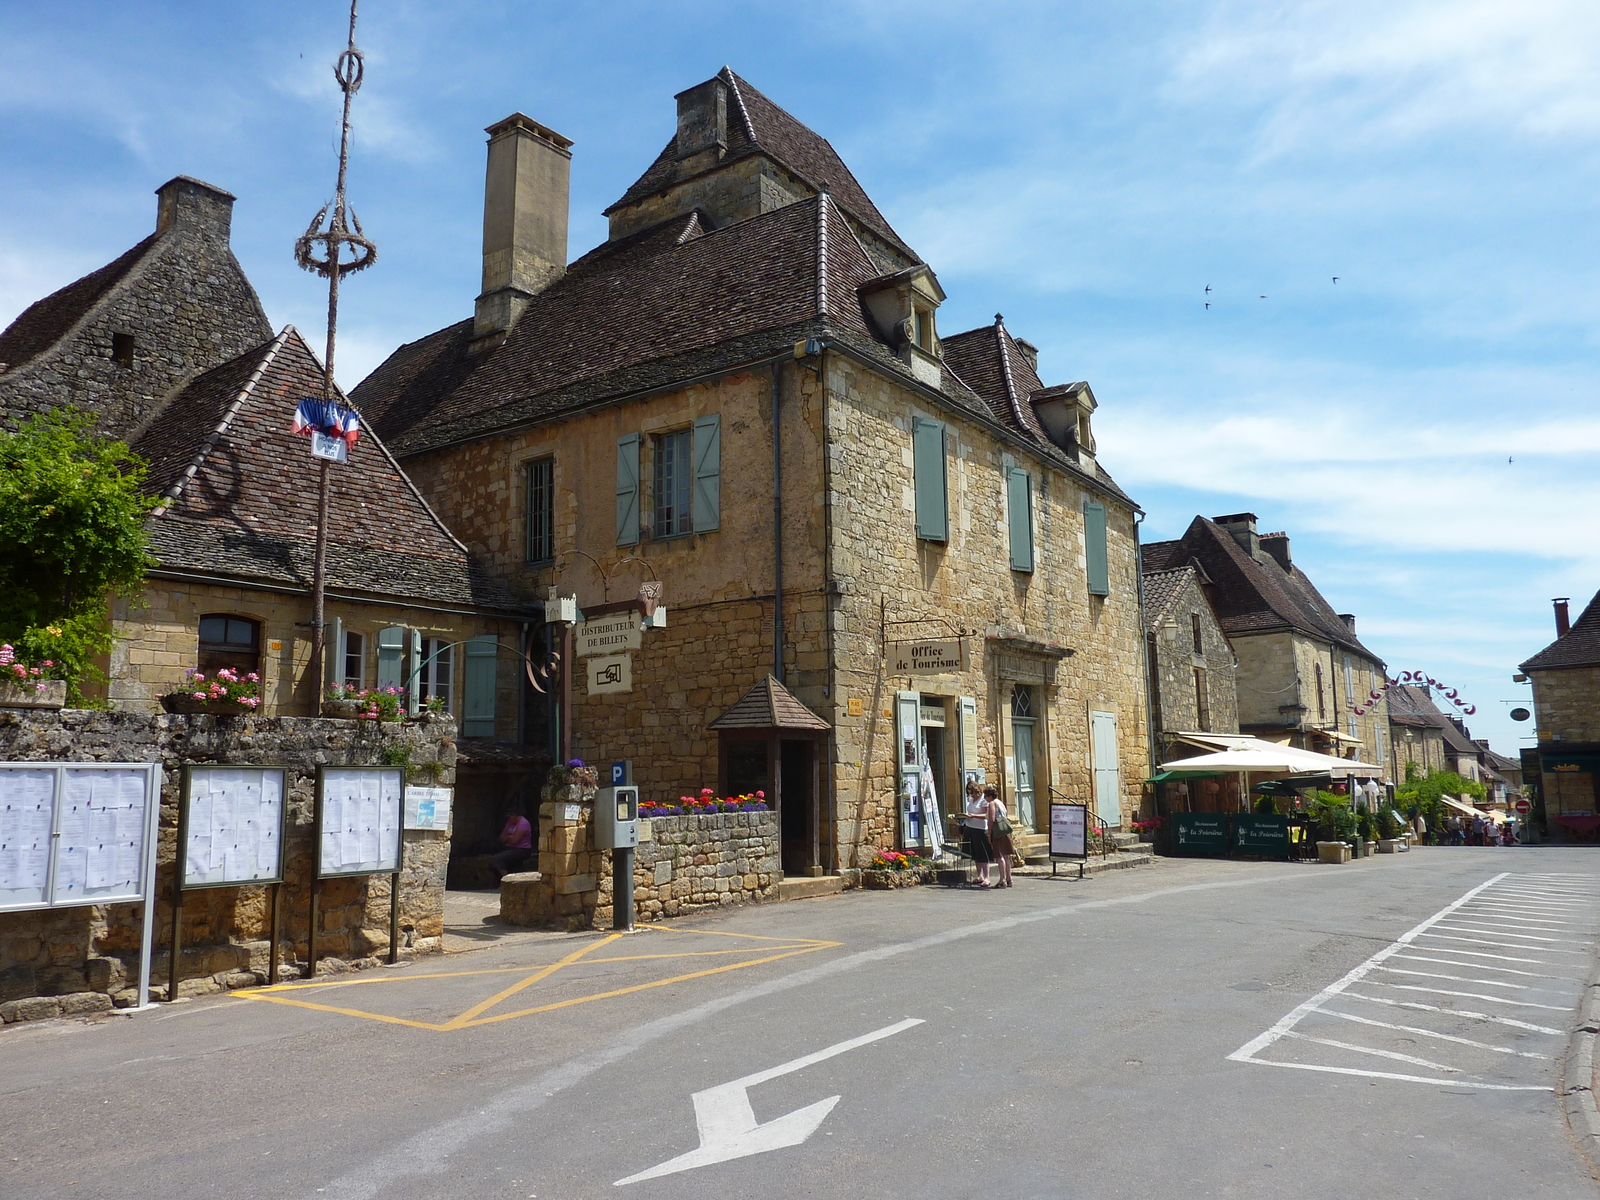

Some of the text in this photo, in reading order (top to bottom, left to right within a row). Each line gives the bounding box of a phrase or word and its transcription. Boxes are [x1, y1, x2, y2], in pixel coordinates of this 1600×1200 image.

[581, 620, 635, 636] DISTRIBUTEUR
[587, 634, 628, 648] DE BILLETS
[911, 645, 943, 658] Office
[896, 657, 959, 670] de Tourisme
[612, 766, 623, 782] P
